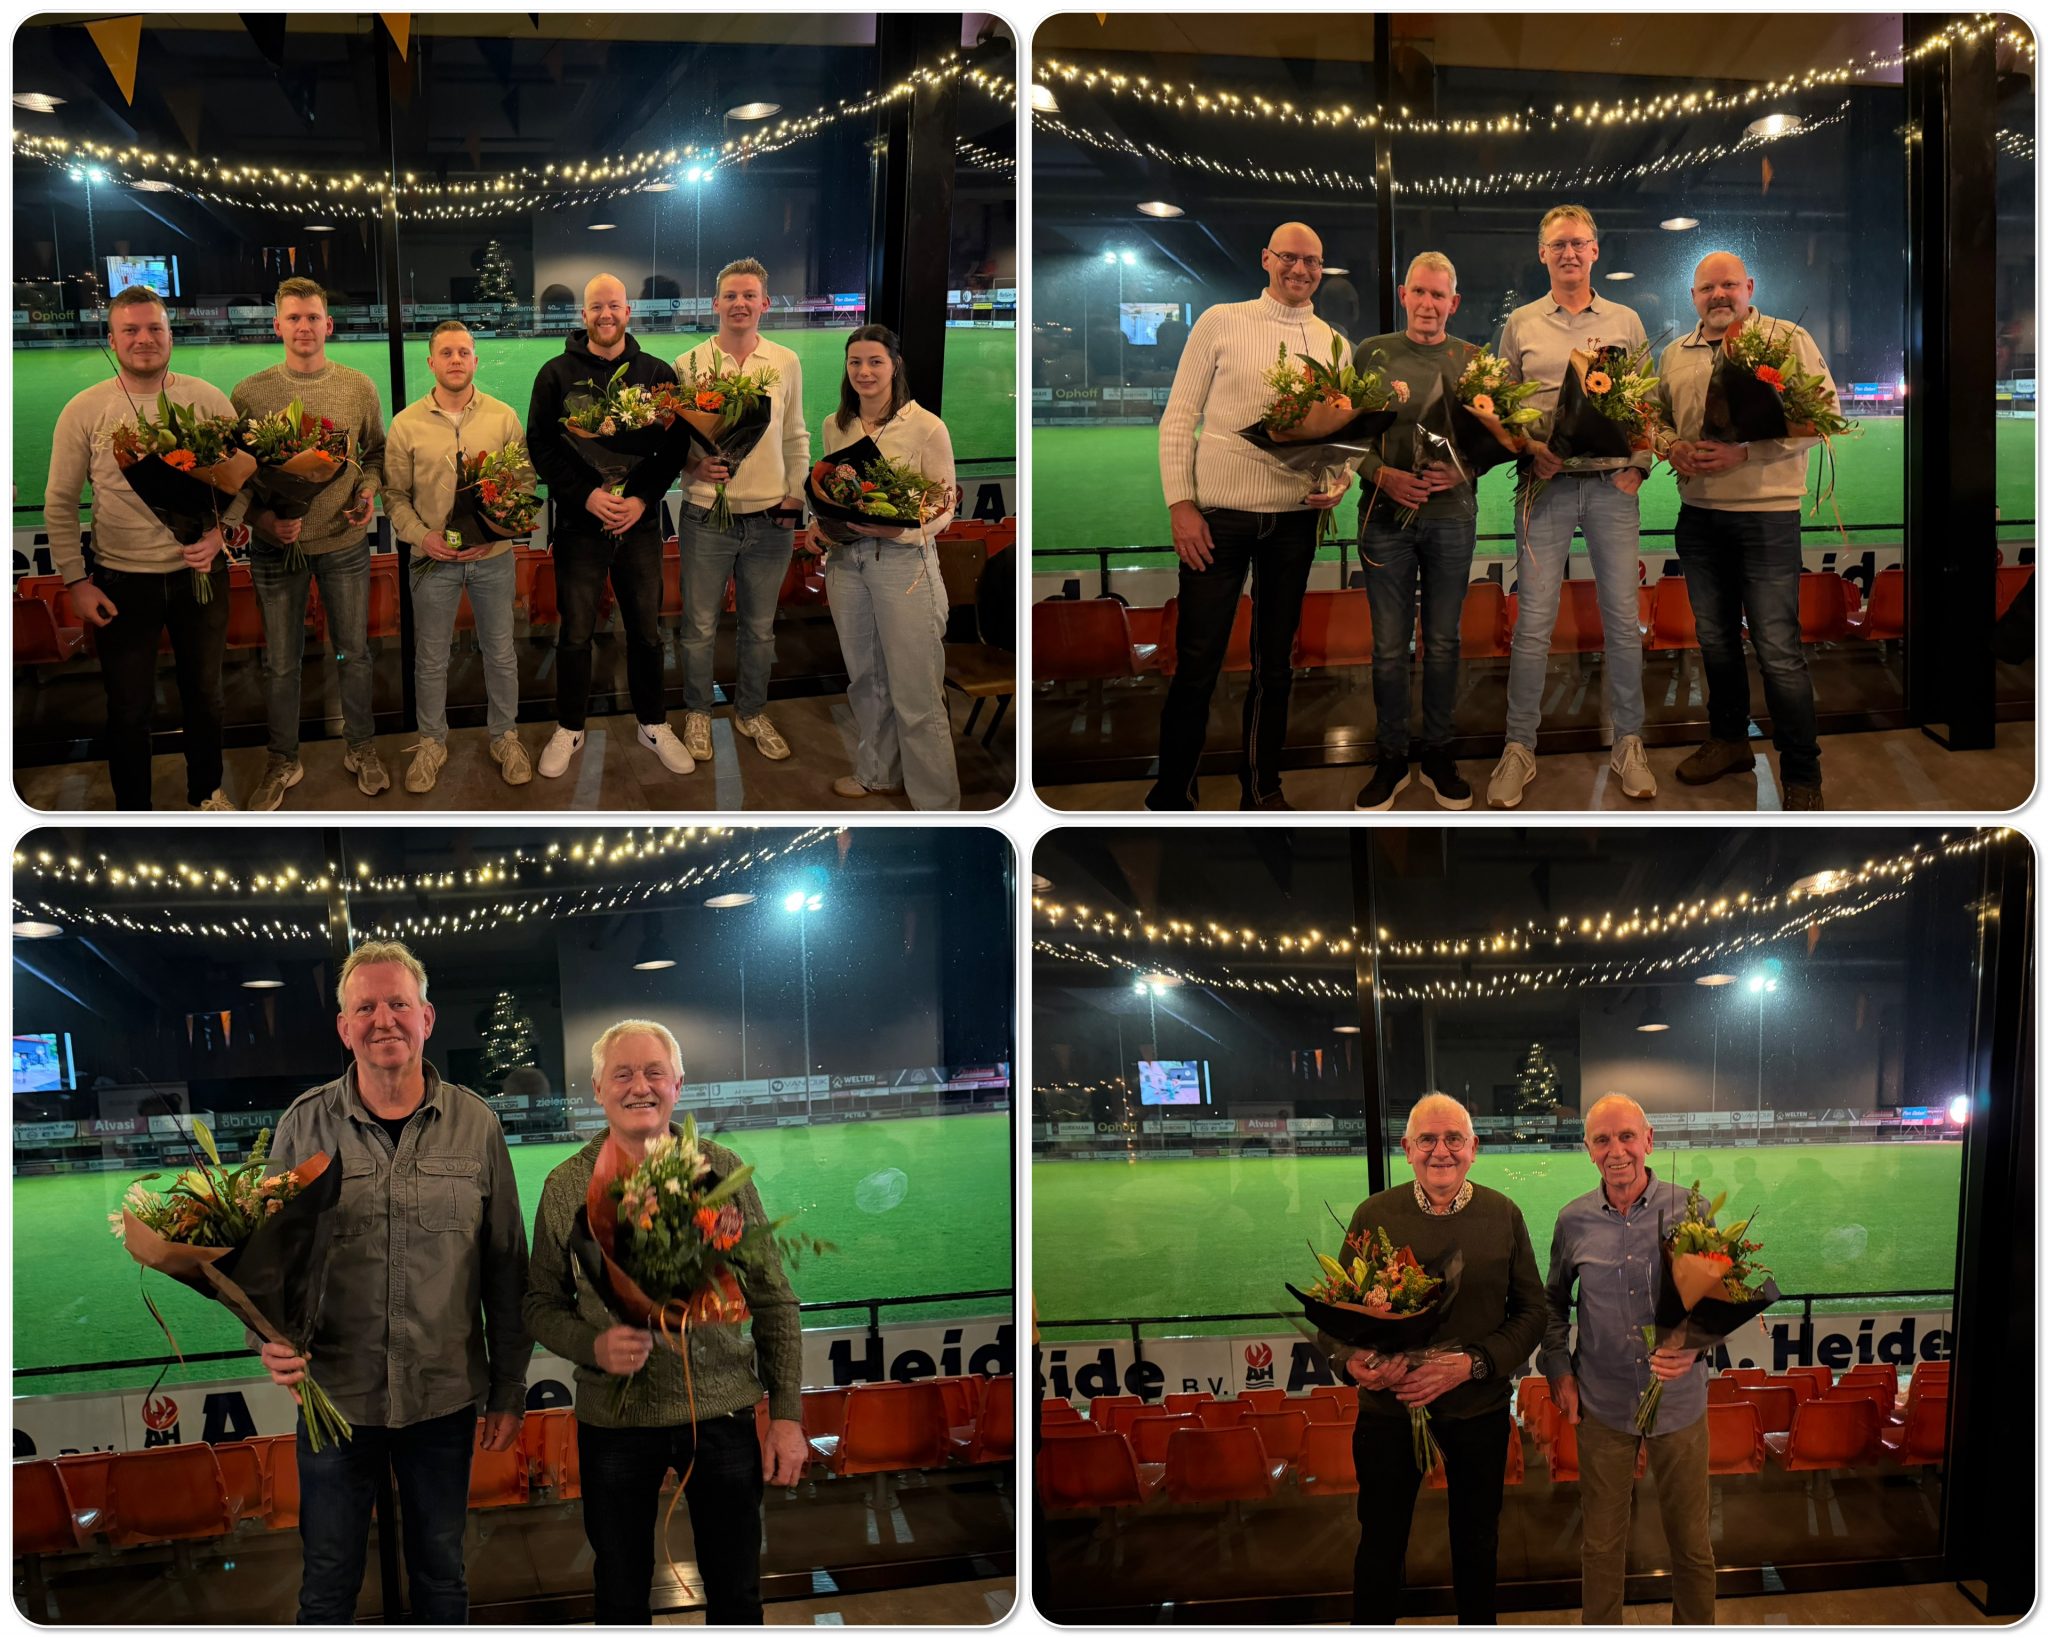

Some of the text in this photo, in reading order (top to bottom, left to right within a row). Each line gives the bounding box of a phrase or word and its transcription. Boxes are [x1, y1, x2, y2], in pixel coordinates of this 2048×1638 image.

[32, 309, 76, 322] Ophoff
[189, 307, 218, 316] Alvasi
[1055, 388, 1099, 401] Ophoff
[843, 1075, 876, 1084] WELTEN
[535, 1097, 584, 1108] zieleman
[94, 1118, 135, 1132] Alvasi
[230, 1112, 273, 1128] bruin
[1248, 1119, 1277, 1129] Alvasi
[1098, 1120, 1138, 1134] Ophoff
[1771, 1317, 1952, 1371] Heide
[1039, 1348, 1165, 1403] ide
